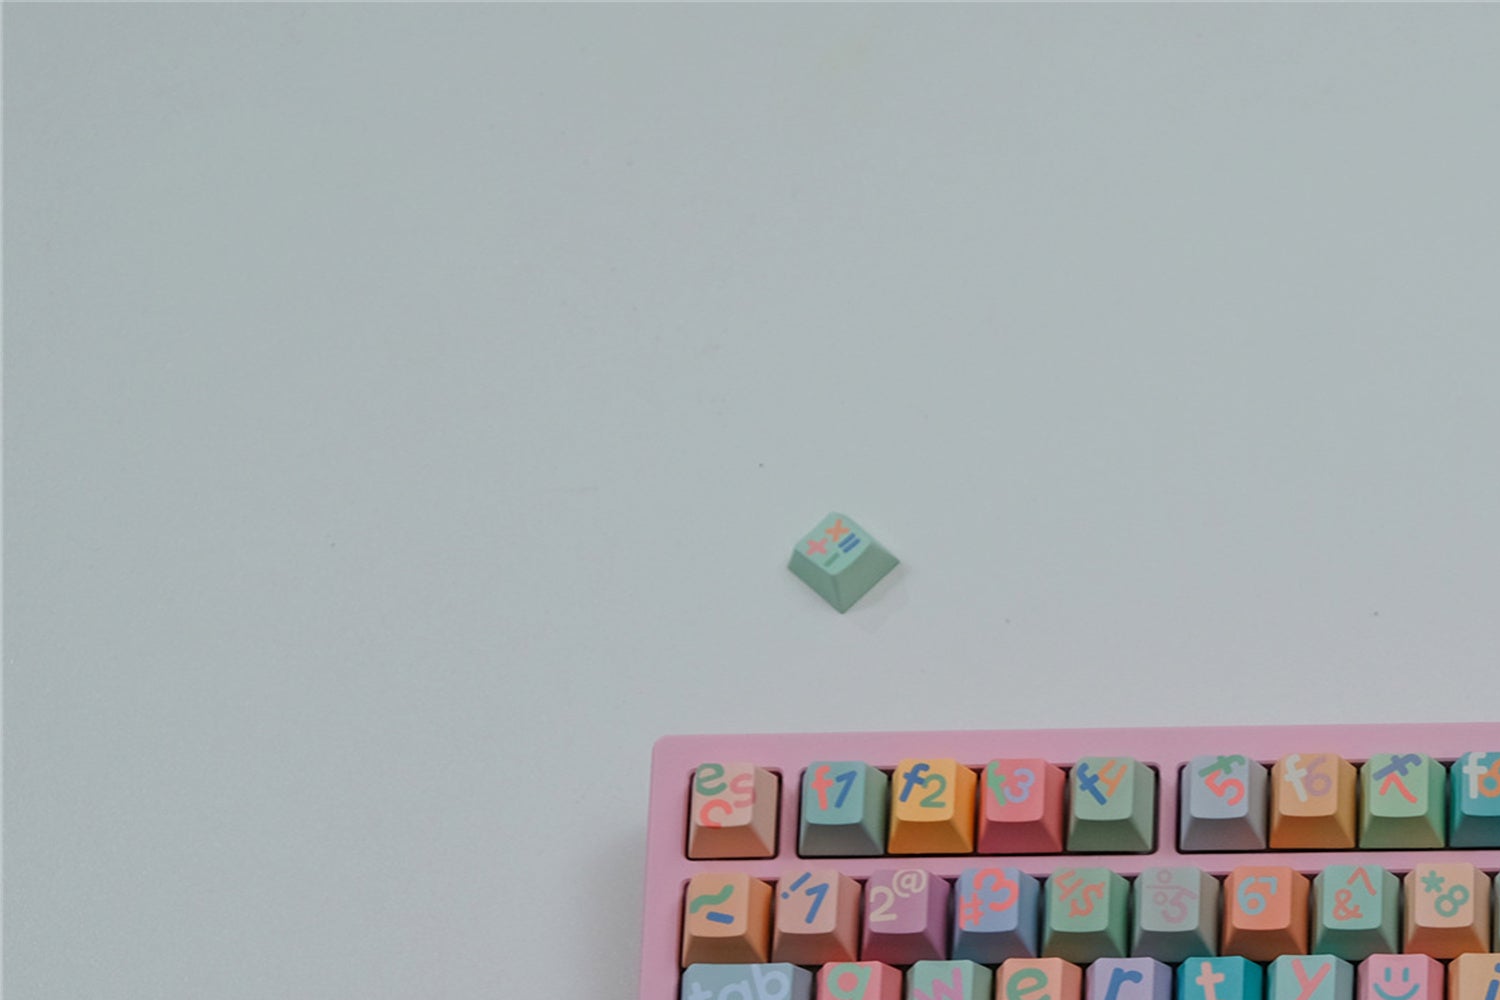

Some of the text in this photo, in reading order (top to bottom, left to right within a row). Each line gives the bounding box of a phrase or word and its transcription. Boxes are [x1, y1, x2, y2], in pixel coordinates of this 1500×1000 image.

[811, 765, 857, 810] f1
[898, 763, 947, 808] f2
[987, 766, 1035, 806] f3
[1077, 760, 1128, 806] f4
[1198, 753, 1246, 806] f5
[1283, 754, 1333, 802] f6
